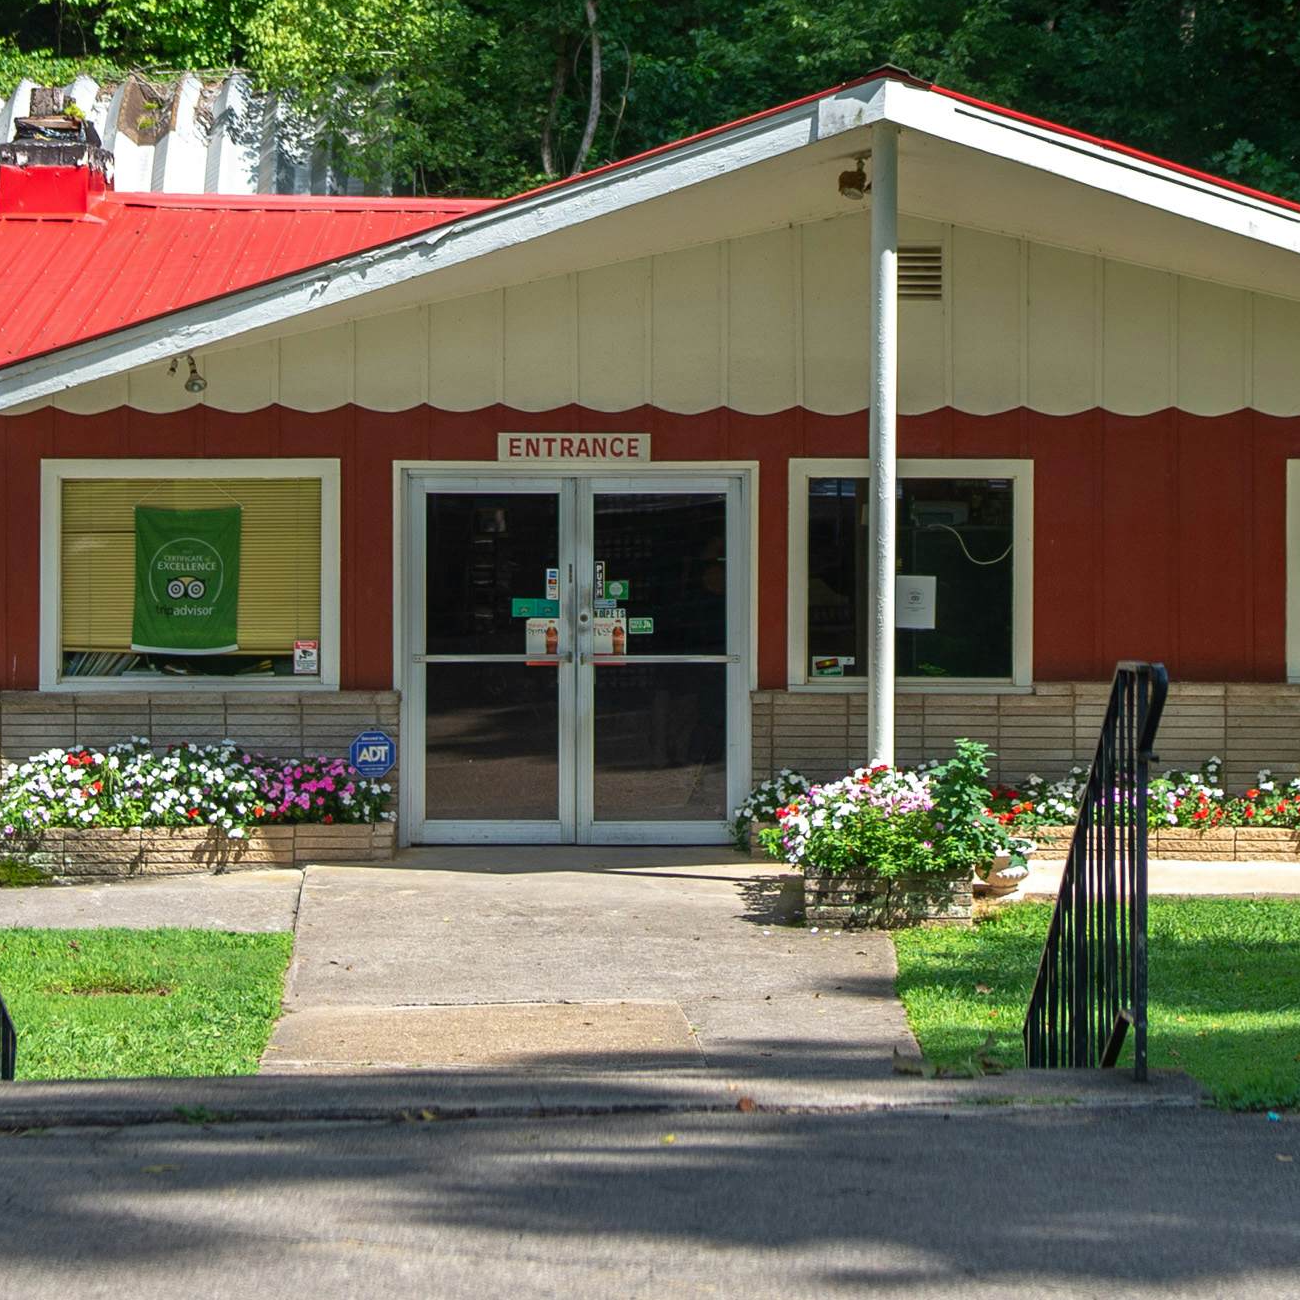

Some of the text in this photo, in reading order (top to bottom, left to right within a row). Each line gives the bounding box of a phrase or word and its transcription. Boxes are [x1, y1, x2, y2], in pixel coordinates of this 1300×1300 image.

[508, 437, 640, 458] ENTRANCE
[157, 562, 217, 571] EXCELLENCE
[156, 604, 214, 617] tripadvisor
[604, 609, 626, 618] PETS
[358, 746, 389, 762] ADT
